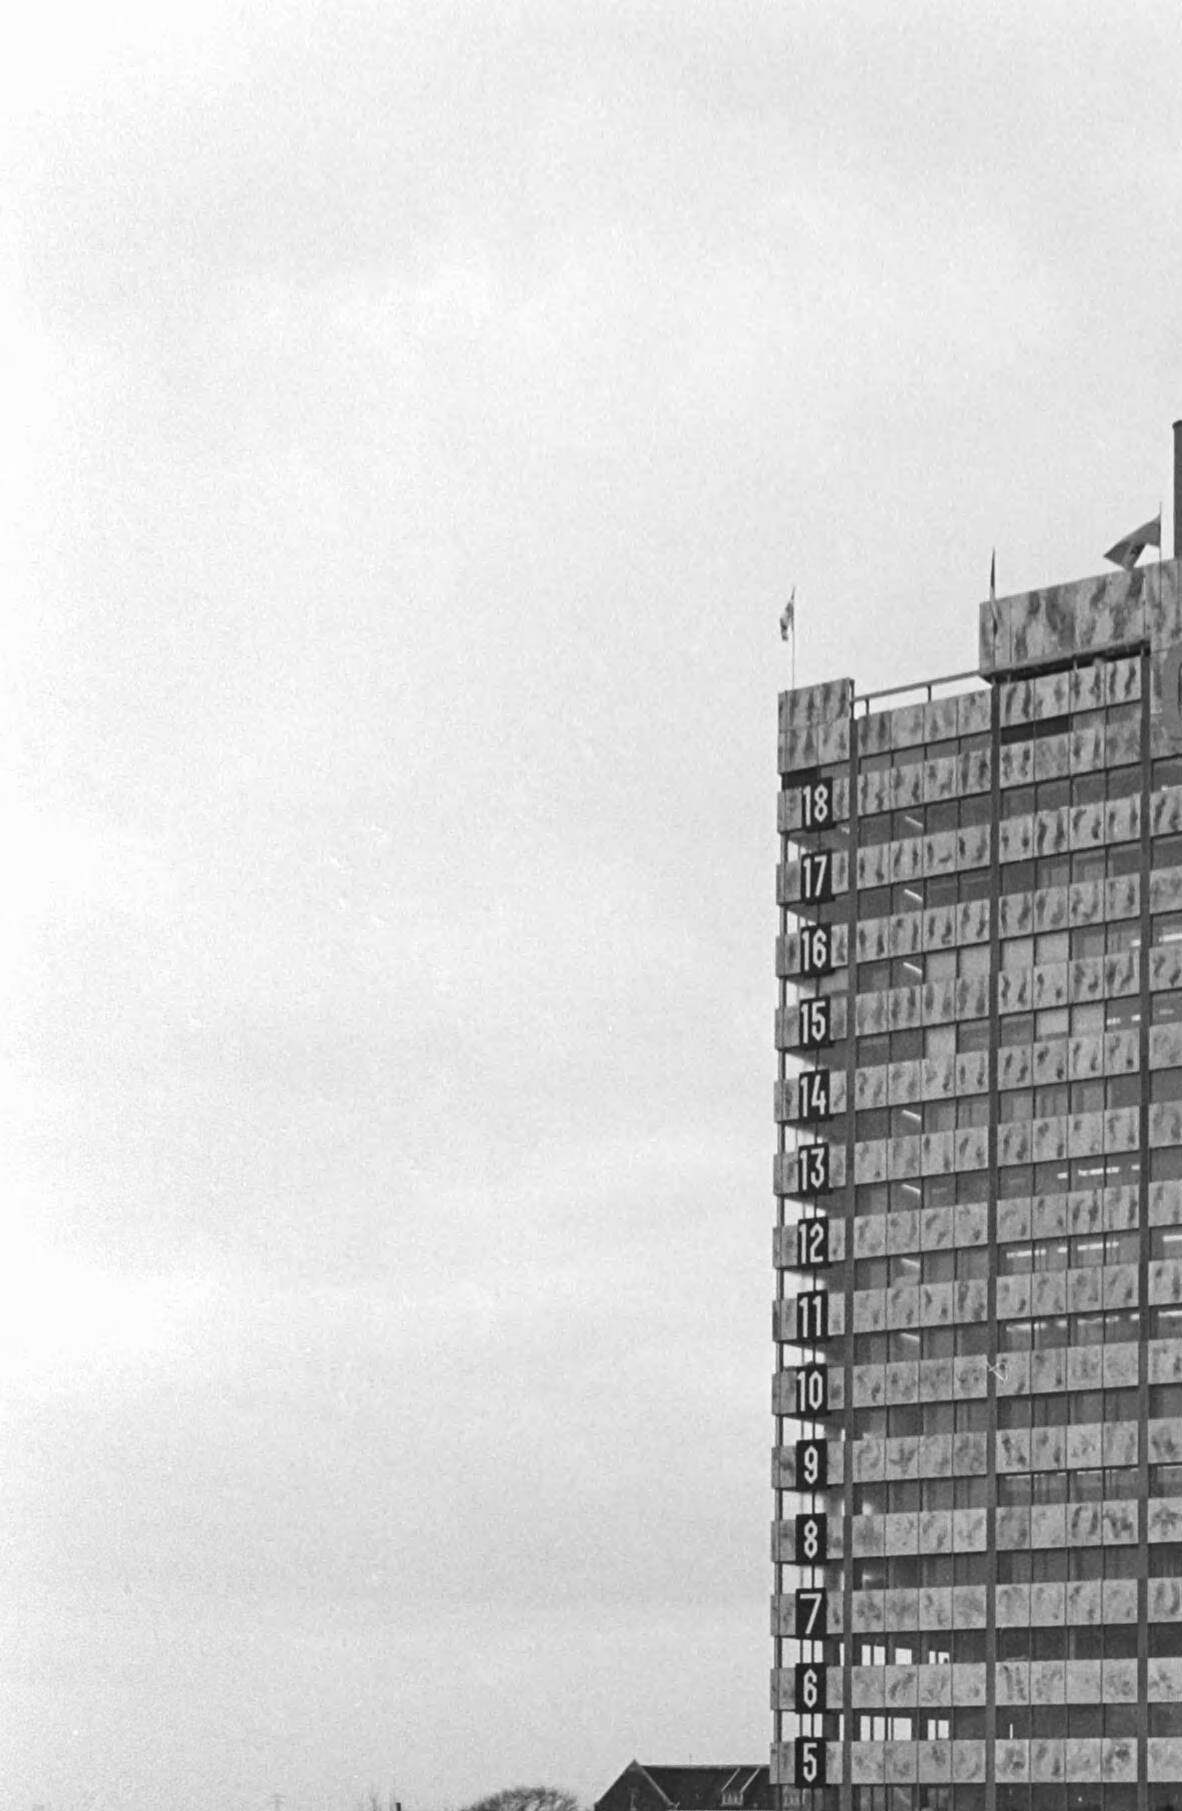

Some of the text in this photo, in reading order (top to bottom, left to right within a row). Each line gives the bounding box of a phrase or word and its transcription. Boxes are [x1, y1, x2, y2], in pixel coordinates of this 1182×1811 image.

[803, 784, 828, 826] 18
[803, 855, 827, 898] 17
[802, 929, 827, 971] 16
[801, 1001, 826, 1044] 15
[800, 1074, 826, 1117] 14
[799, 1147, 825, 1191] 13
[799, 1223, 824, 1264] 12
[799, 1295, 822, 1338] 11
[797, 1371, 823, 1412] 10
[804, 1445, 818, 1484] 9
[804, 1519, 818, 1559] 8
[799, 1593, 822, 1634] 7
[803, 1669, 817, 1708] 6
[803, 1742, 817, 1782] 5
